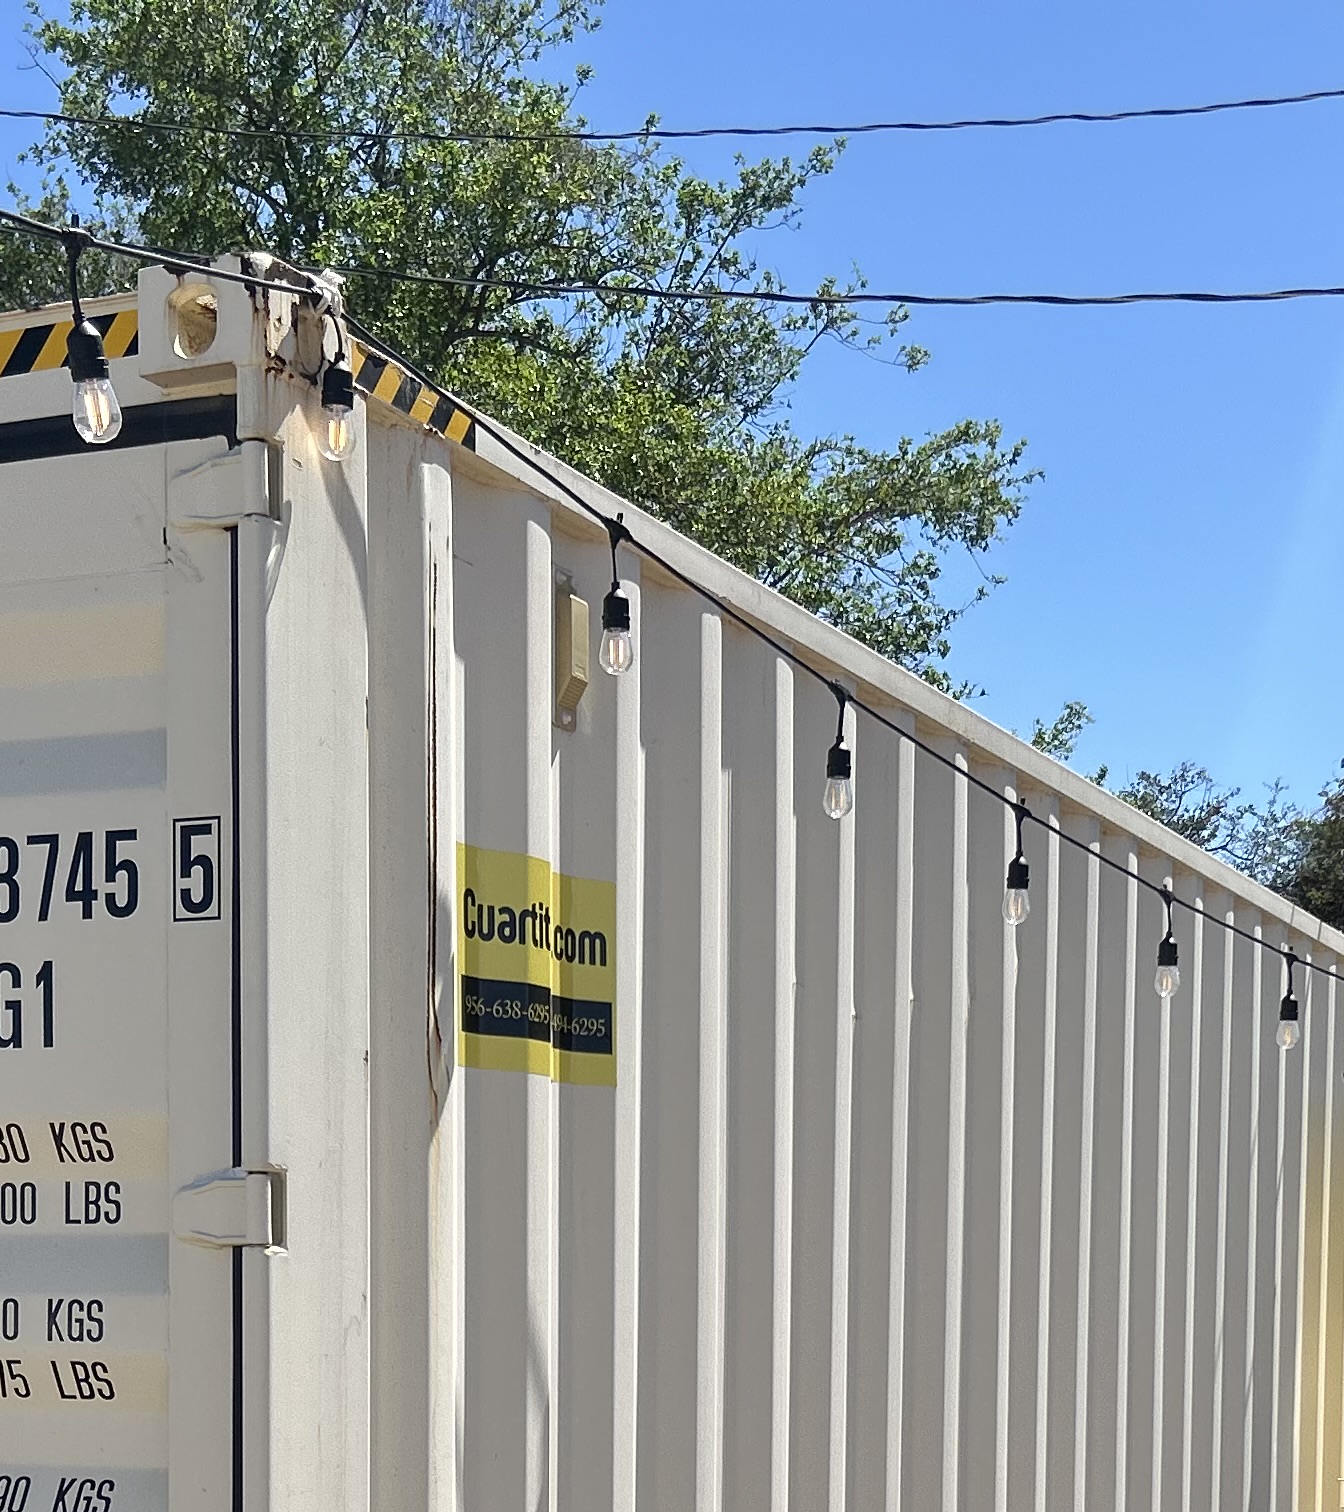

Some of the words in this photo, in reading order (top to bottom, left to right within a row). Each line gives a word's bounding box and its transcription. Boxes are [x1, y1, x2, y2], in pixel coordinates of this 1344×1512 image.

[179, 823, 214, 915] 5
[465, 995, 550, 1025] 956-638-6295
[48, 1121, 115, 1164] KGS
[64, 1180, 121, 1225] LBS
[47, 1298, 104, 1343] KGS
[50, 1360, 116, 1401] LBS
